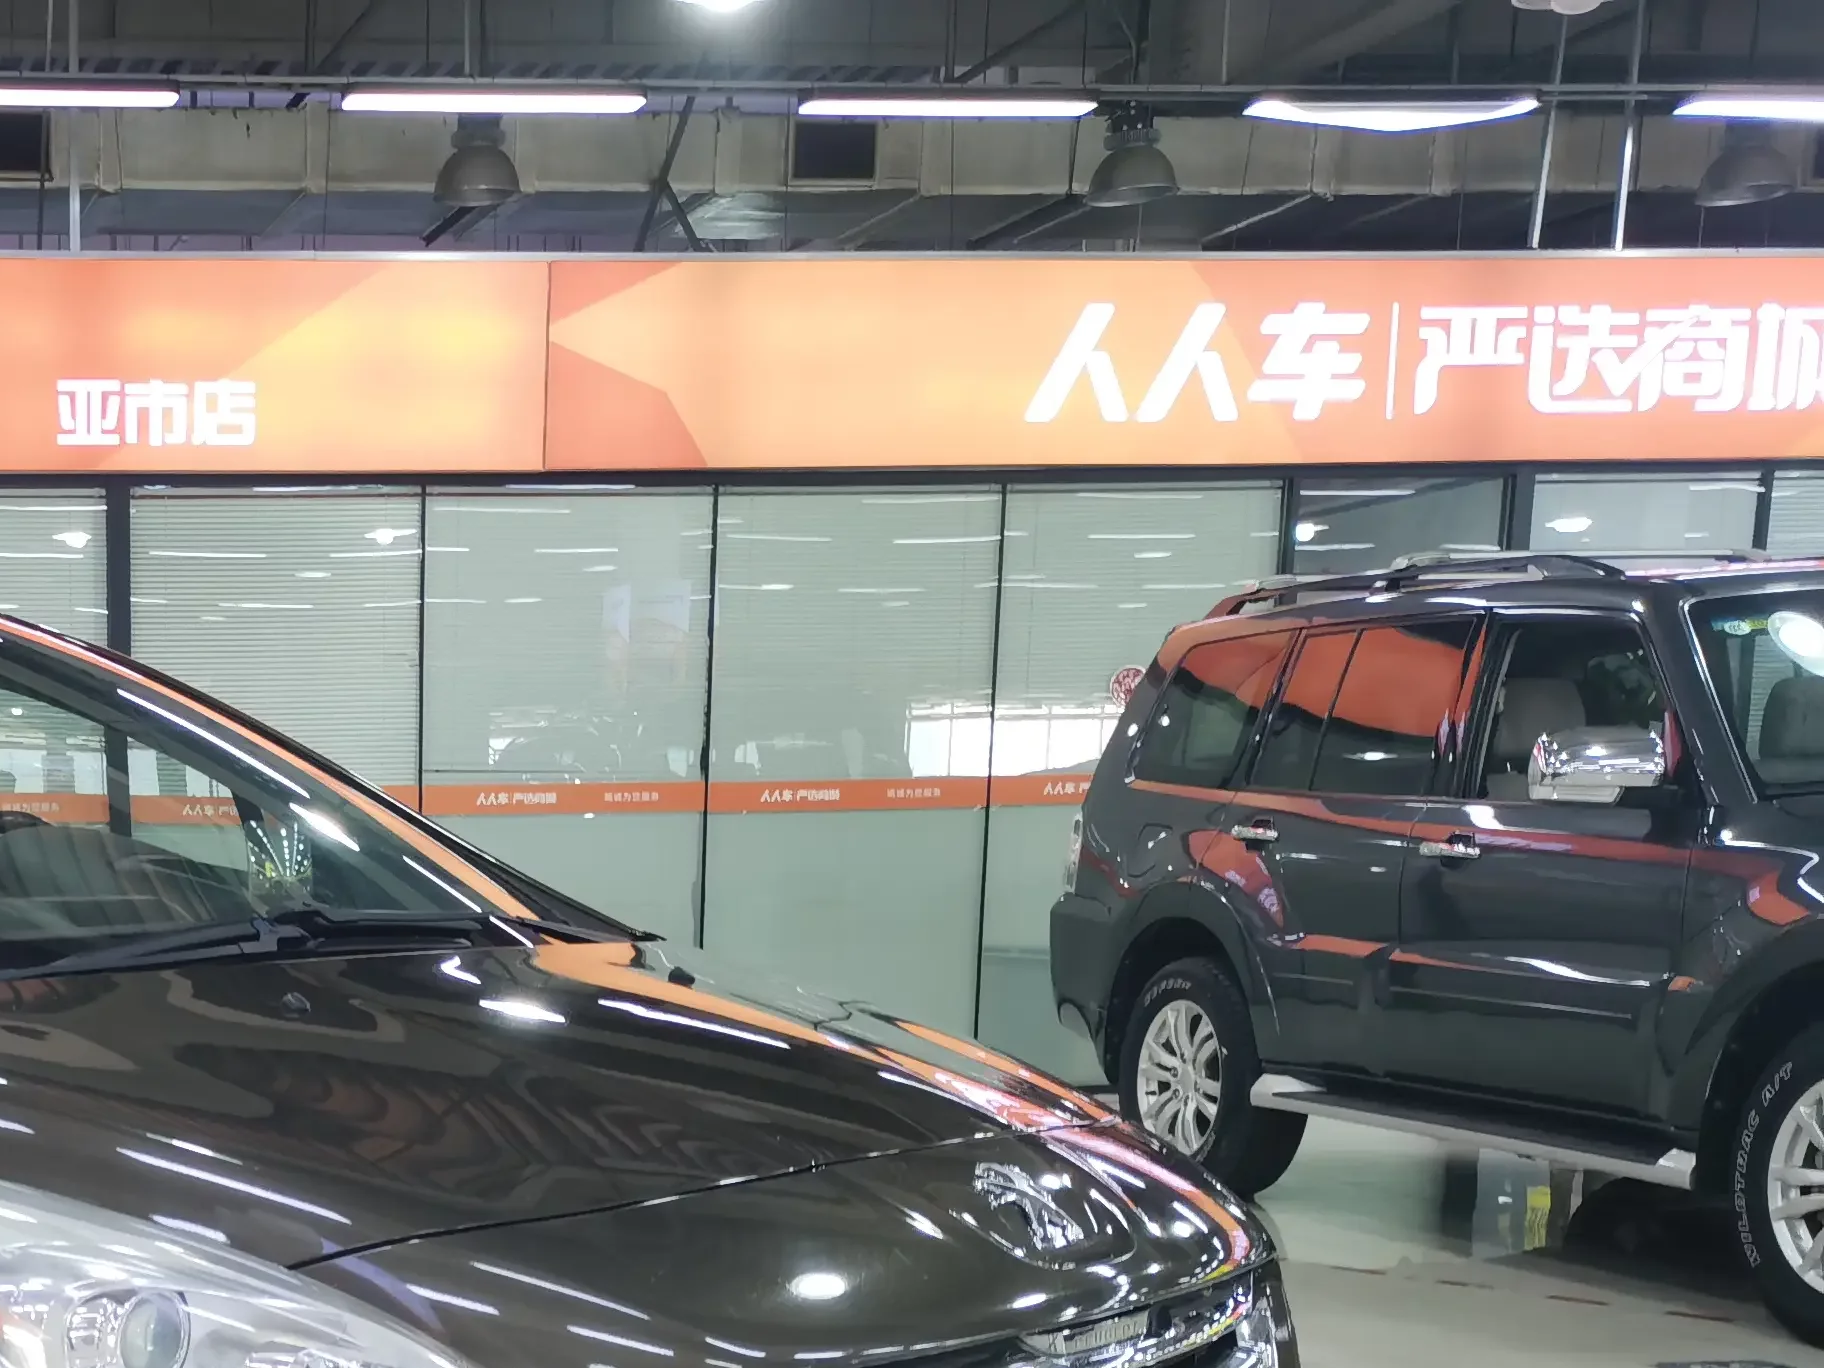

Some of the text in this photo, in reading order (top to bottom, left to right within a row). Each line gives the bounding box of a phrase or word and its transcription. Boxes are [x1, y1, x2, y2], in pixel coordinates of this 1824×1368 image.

[1024, 301, 1371, 423] 人人车
[56, 378, 257, 447] 亚市店
[1760, 1061, 1793, 1108] A/T
